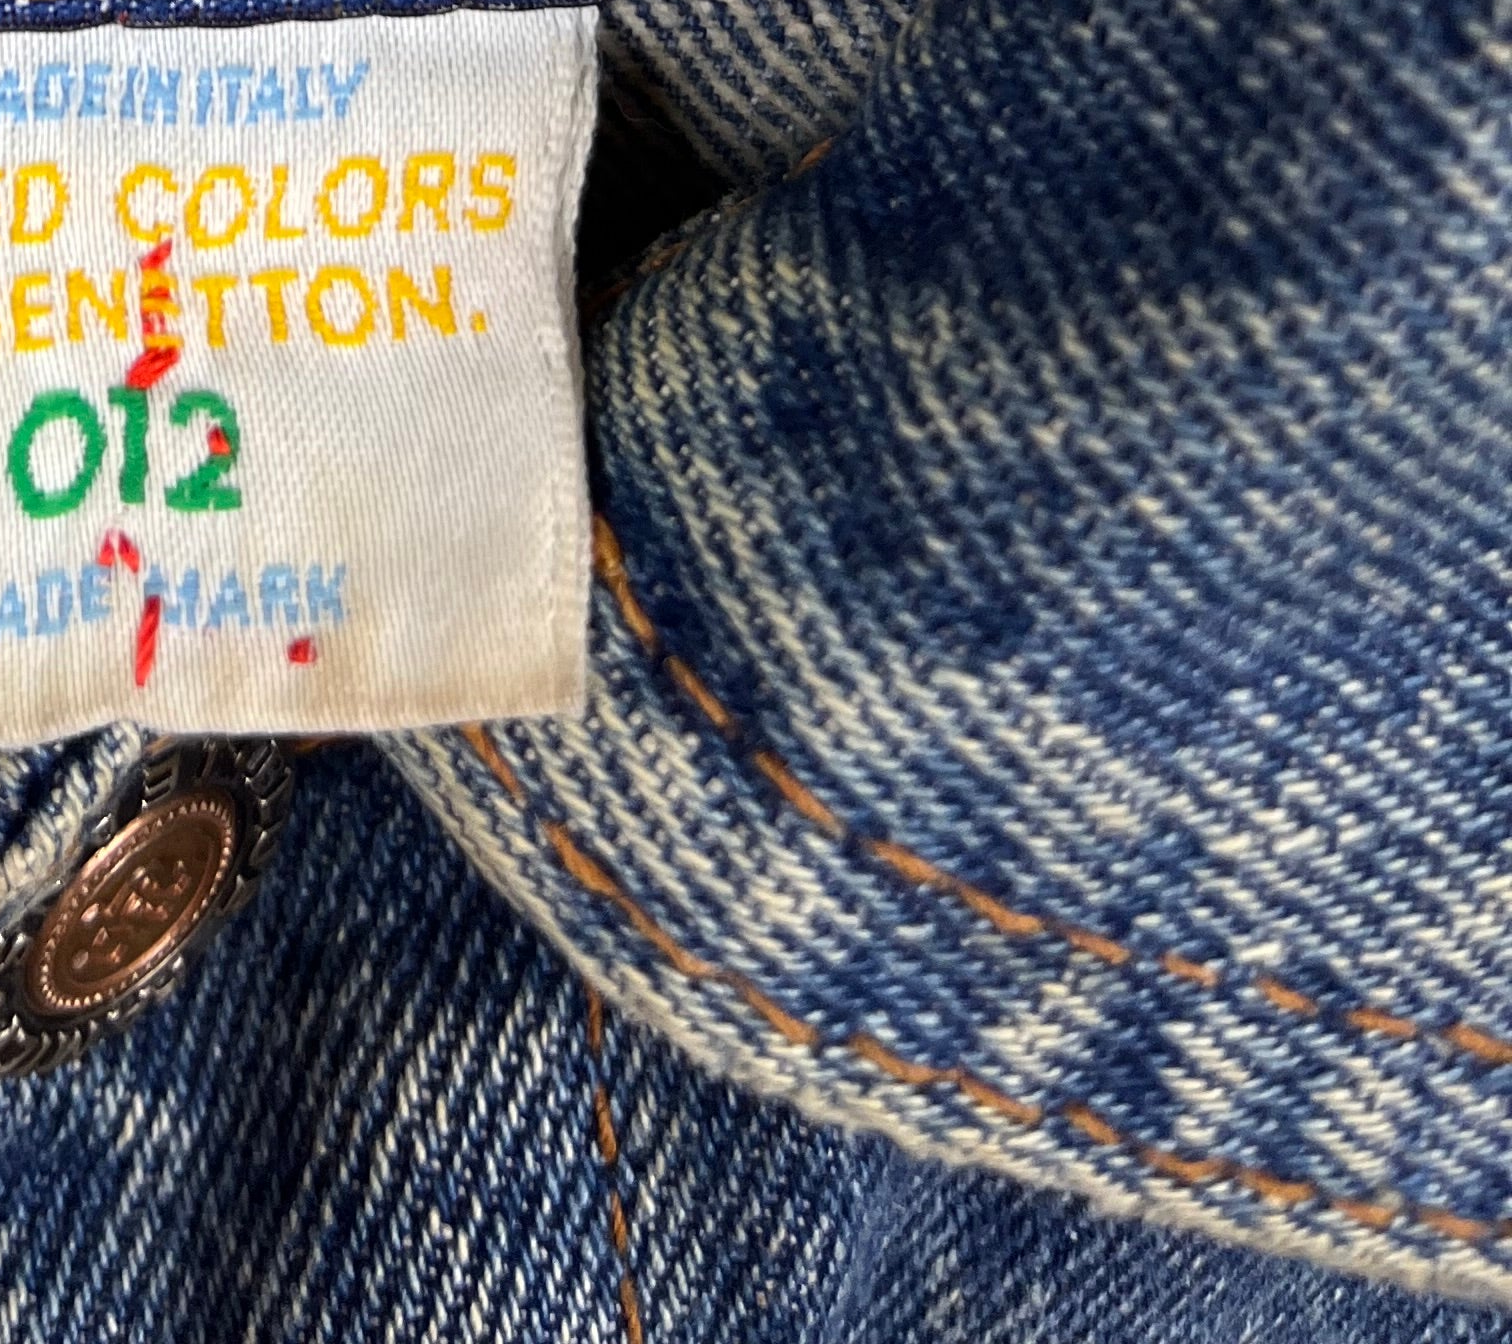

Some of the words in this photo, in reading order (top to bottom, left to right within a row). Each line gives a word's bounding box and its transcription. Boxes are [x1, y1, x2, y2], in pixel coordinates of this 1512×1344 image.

[120, 65, 181, 125] IN
[194, 57, 369, 126] ITALY
[114, 149, 517, 243] COLORS
[6, 385, 243, 519] 012
[143, 562, 350, 629] MARK
